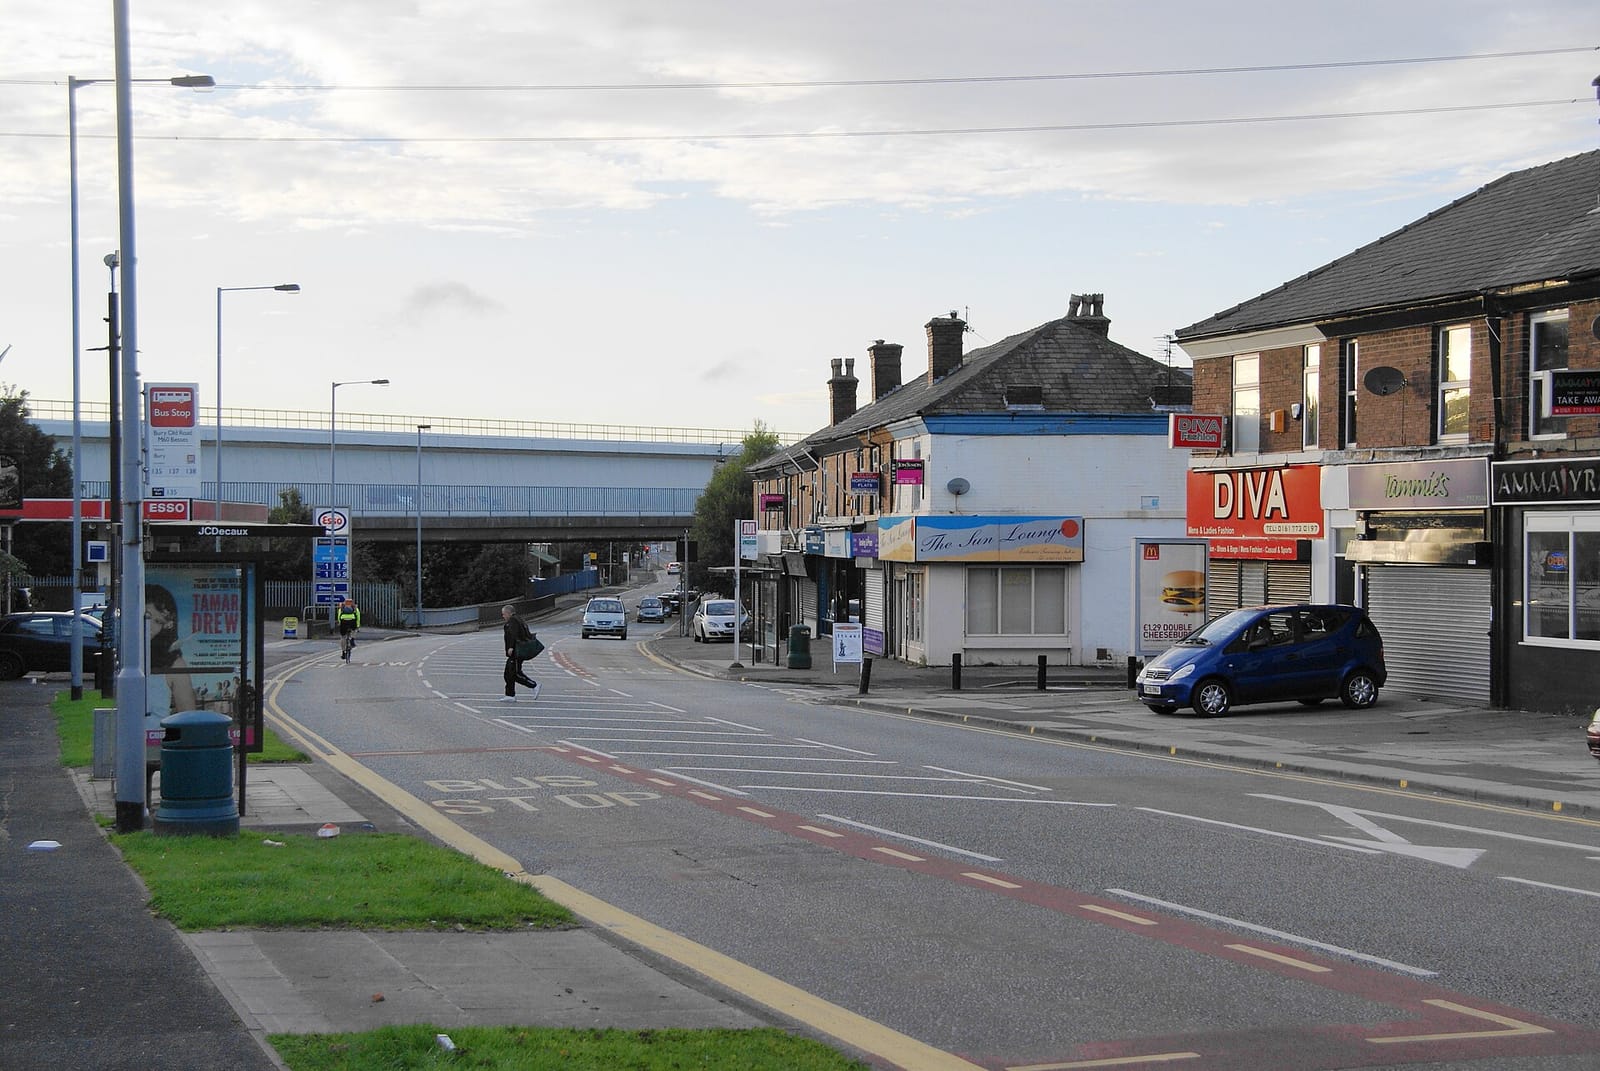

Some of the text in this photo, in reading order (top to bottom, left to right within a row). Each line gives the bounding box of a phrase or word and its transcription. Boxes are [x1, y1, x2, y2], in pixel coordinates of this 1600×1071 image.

[1557, 396, 1579, 405] TAKE
[154, 408, 191, 419] Bus Stop
[1178, 418, 1221, 432] DIVA
[1181, 431, 1217, 442] Fashion
[1214, 470, 1288, 519] DIVA
[149, 503, 185, 513] ESSO
[198, 526, 248, 536] JCDecaux
[1203, 525, 1217, 534] Ladies
[1217, 525, 1235, 534] Fashion
[920, 524, 1064, 553] The Sun Lounge
[1547, 557, 1567, 566] OPEN
[192, 593, 239, 611] TAMAR
[191, 612, 239, 634] DREW
[1143, 631, 1190, 639] CHEESEBUR
[424, 775, 599, 793] BUS
[431, 791, 662, 815] STOP
